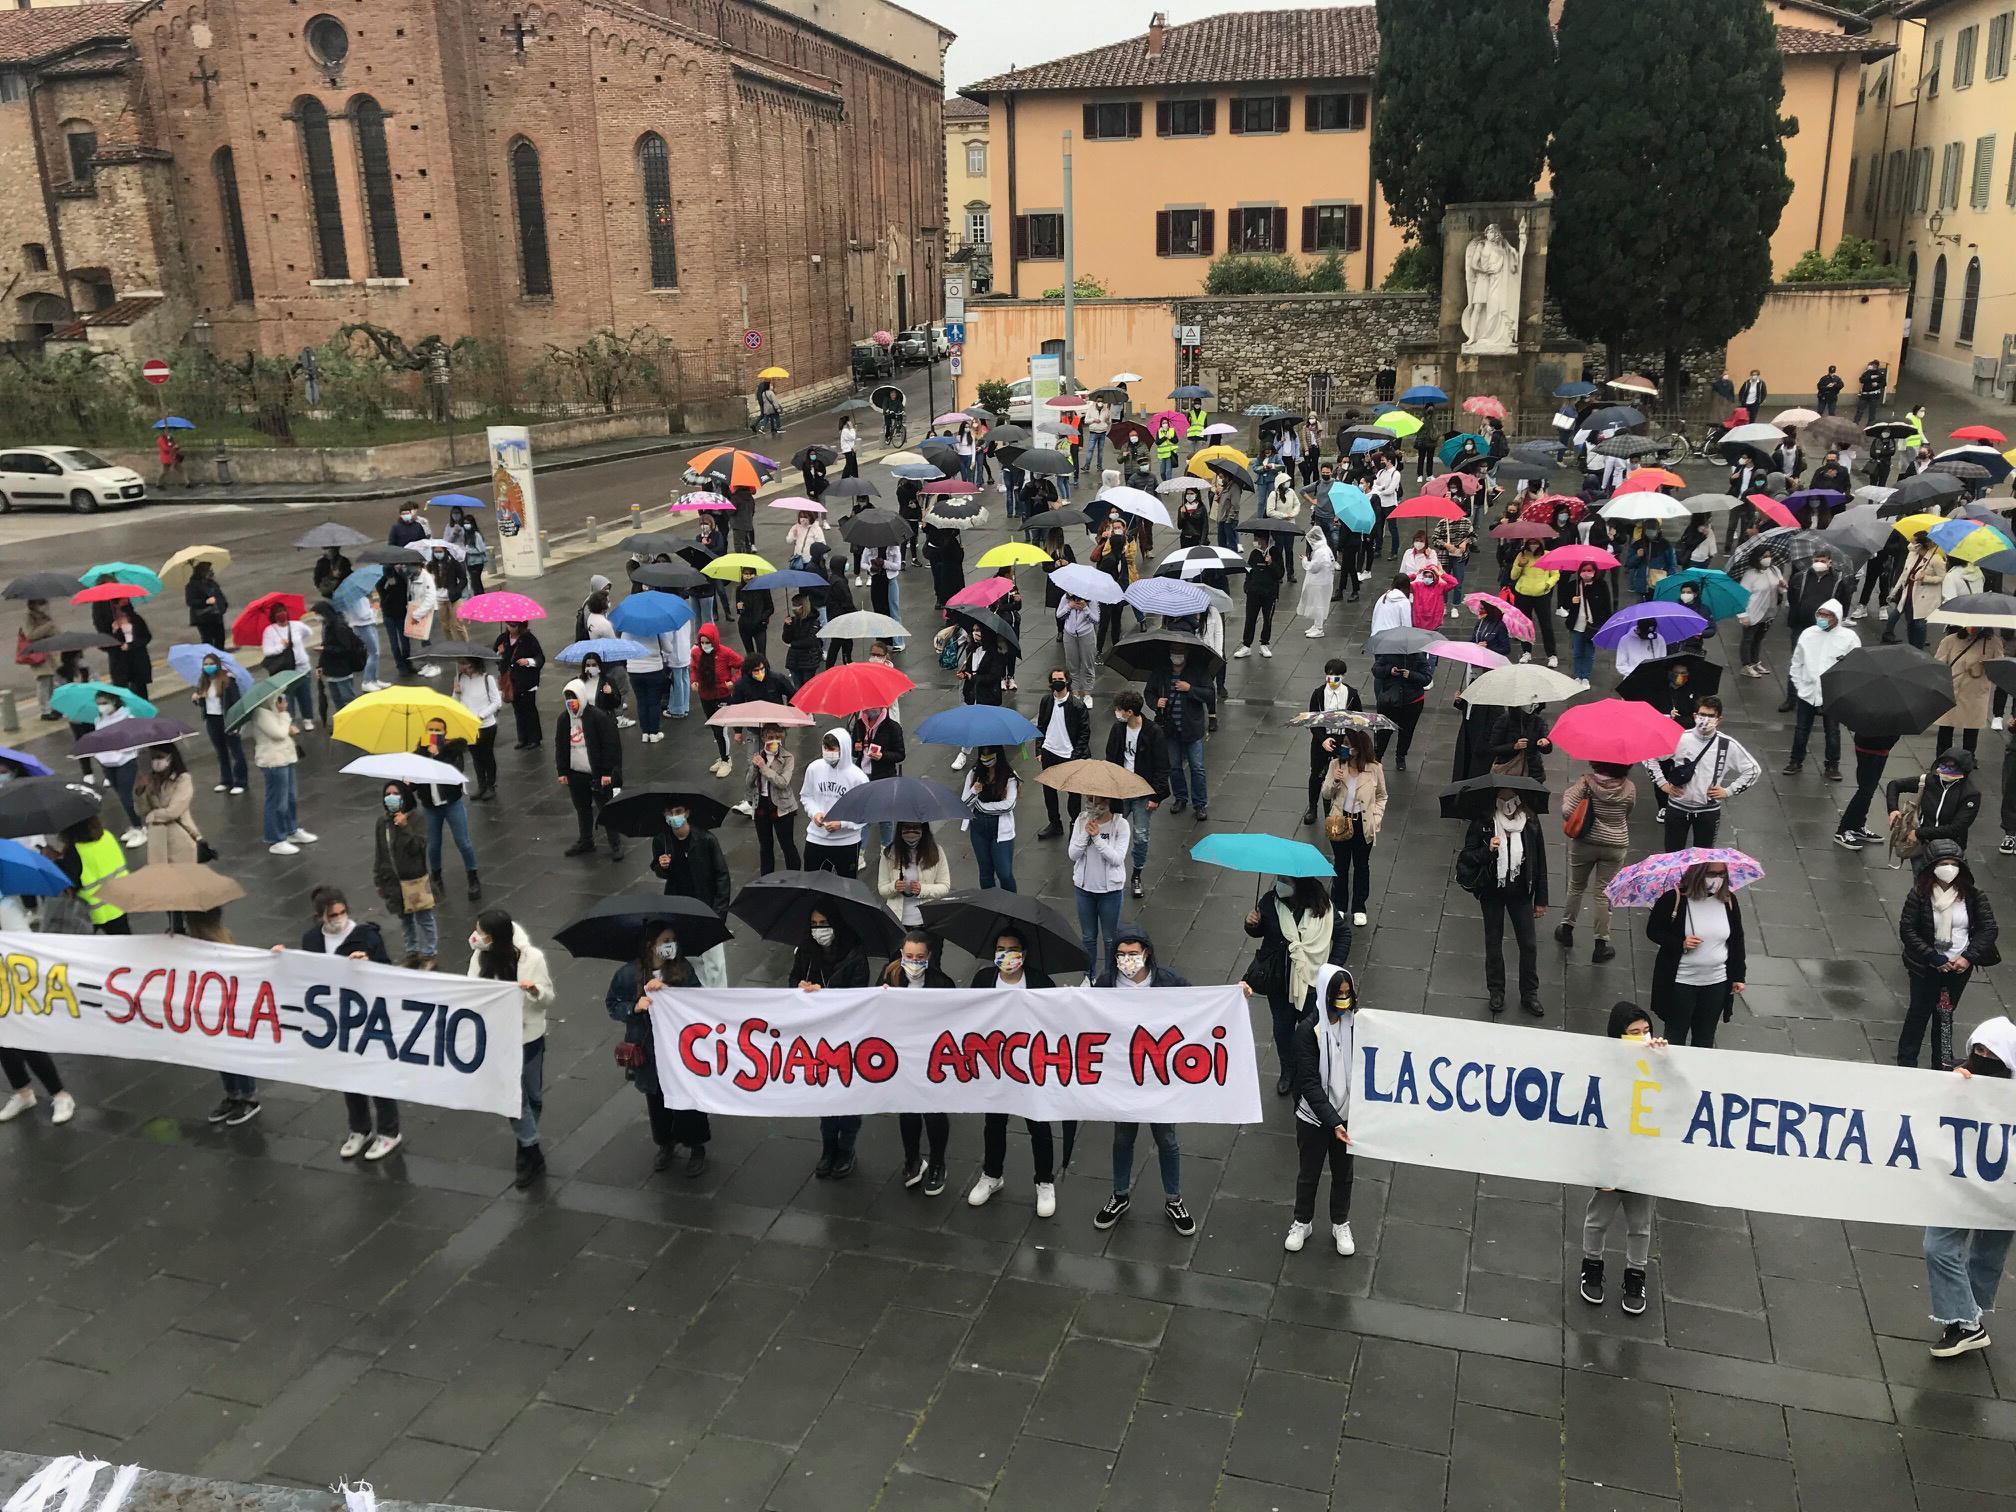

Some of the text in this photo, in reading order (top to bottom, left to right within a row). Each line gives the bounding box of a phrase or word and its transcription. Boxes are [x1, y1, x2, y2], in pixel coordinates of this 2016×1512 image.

[927, 1030, 1111, 1087] ANCHE
[1628, 1059, 1662, 1137] È
[1681, 1090, 1873, 1165] APERTA
[1885, 1114, 1922, 1171] A
[1939, 1116, 2016, 1185] TU
